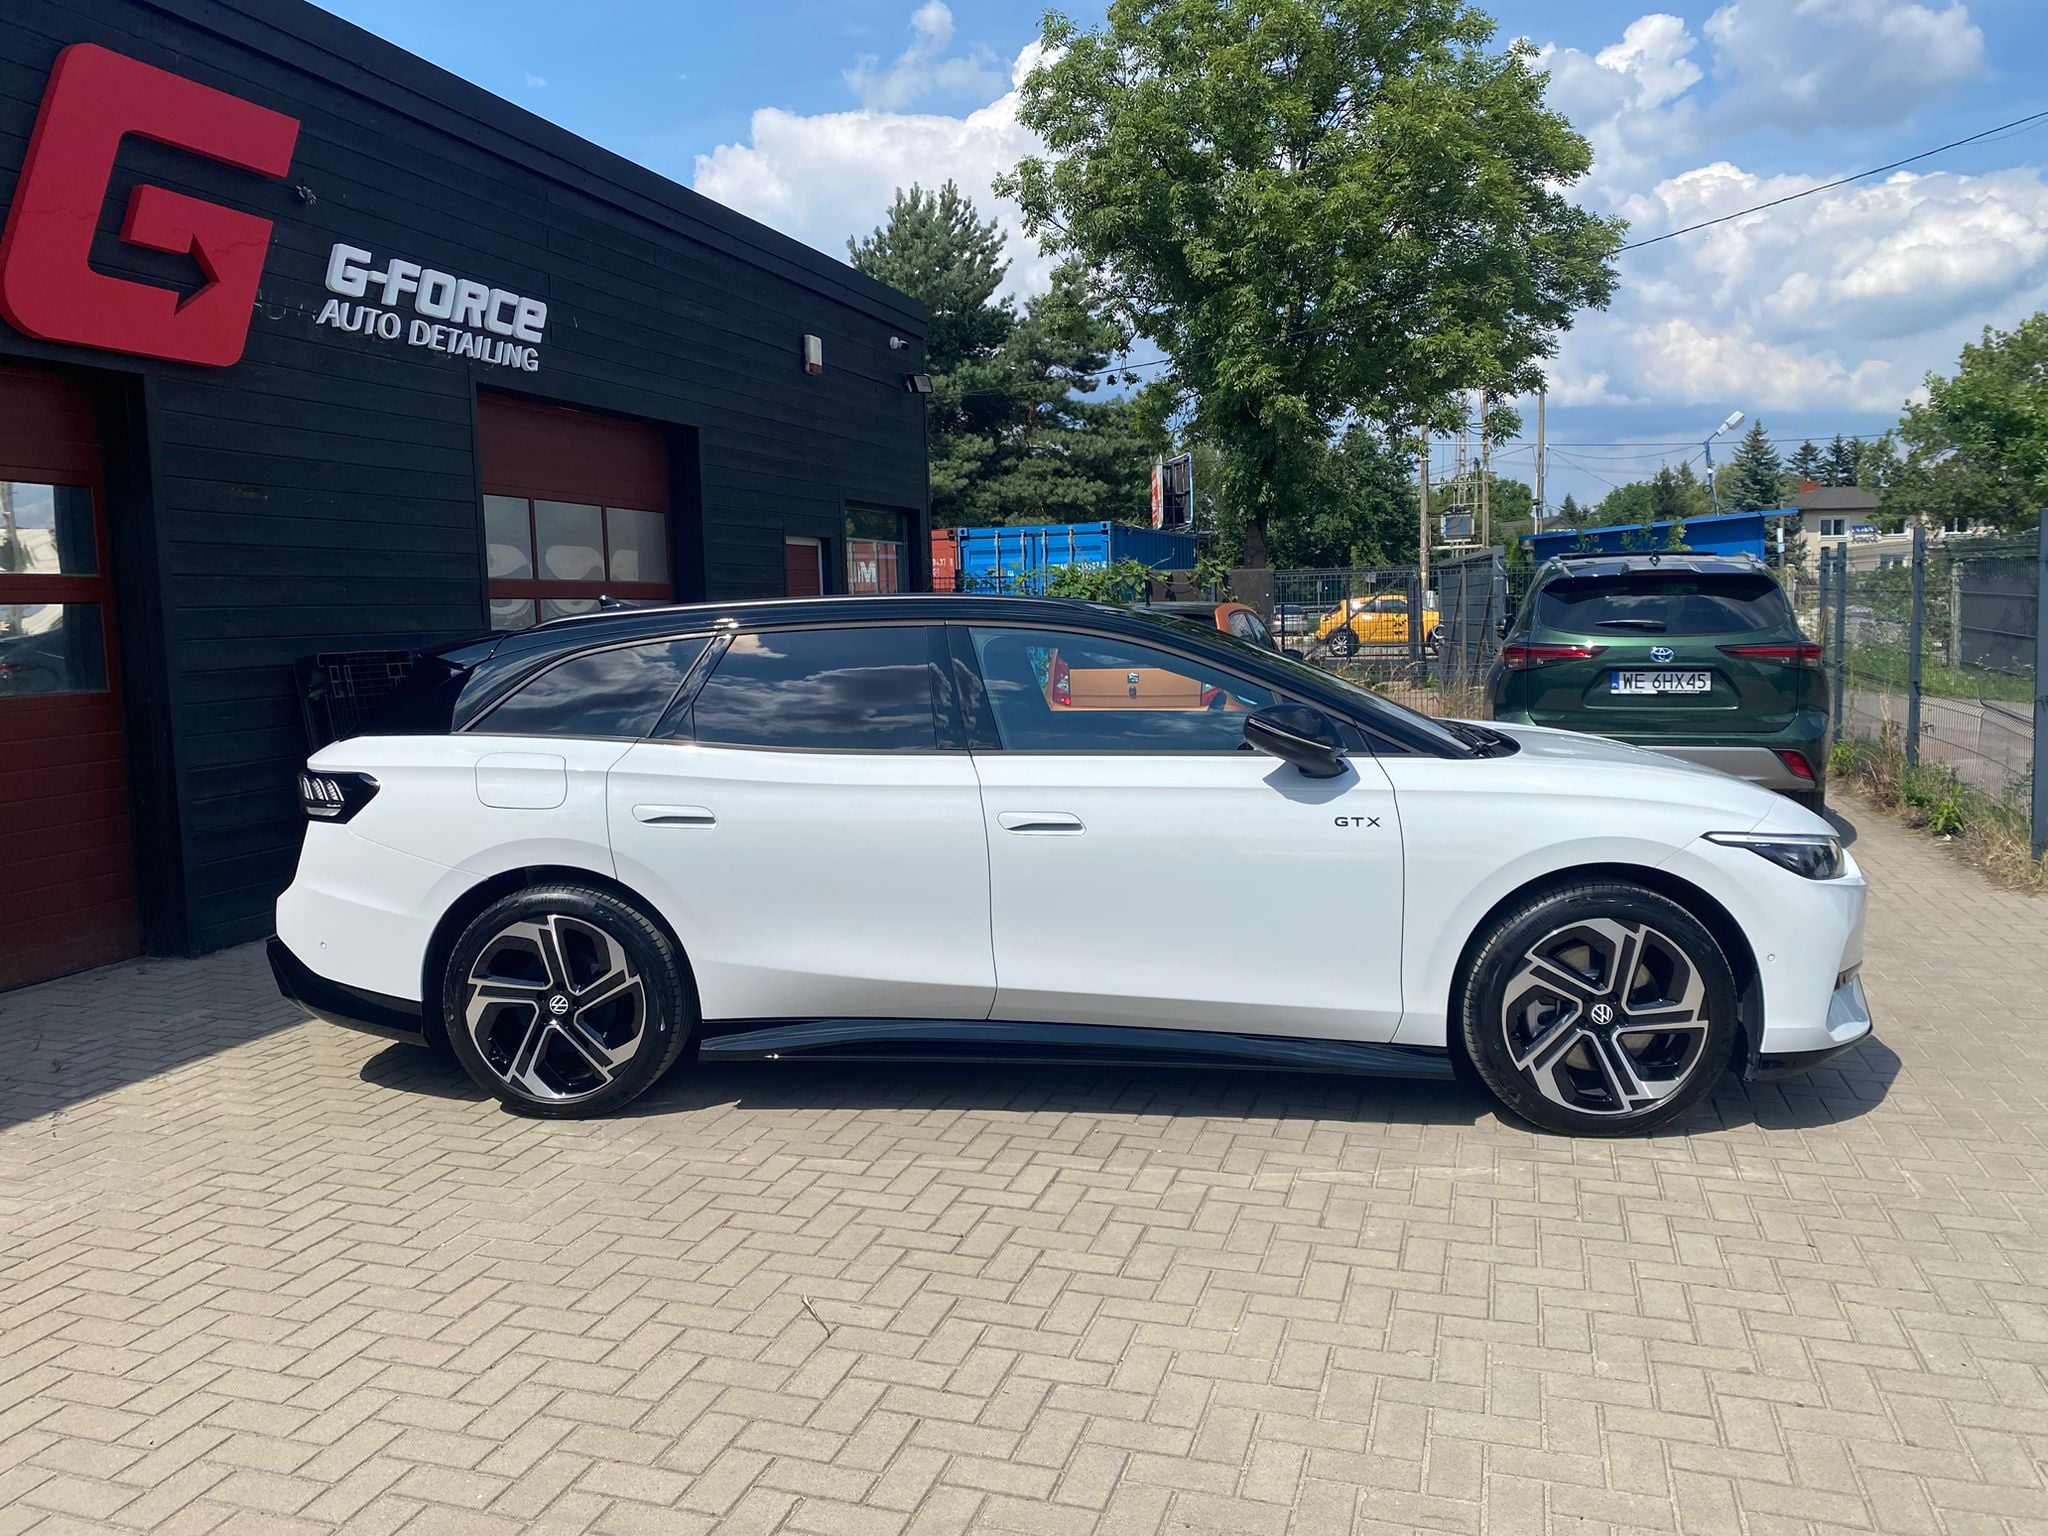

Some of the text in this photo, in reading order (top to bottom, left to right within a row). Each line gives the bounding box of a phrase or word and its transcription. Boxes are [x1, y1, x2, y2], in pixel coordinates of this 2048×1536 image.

[316, 299, 539, 372] AUTO DETAILING
[1623, 673, 1706, 689] WE 6HX45
[1334, 816, 1381, 827] GTX
